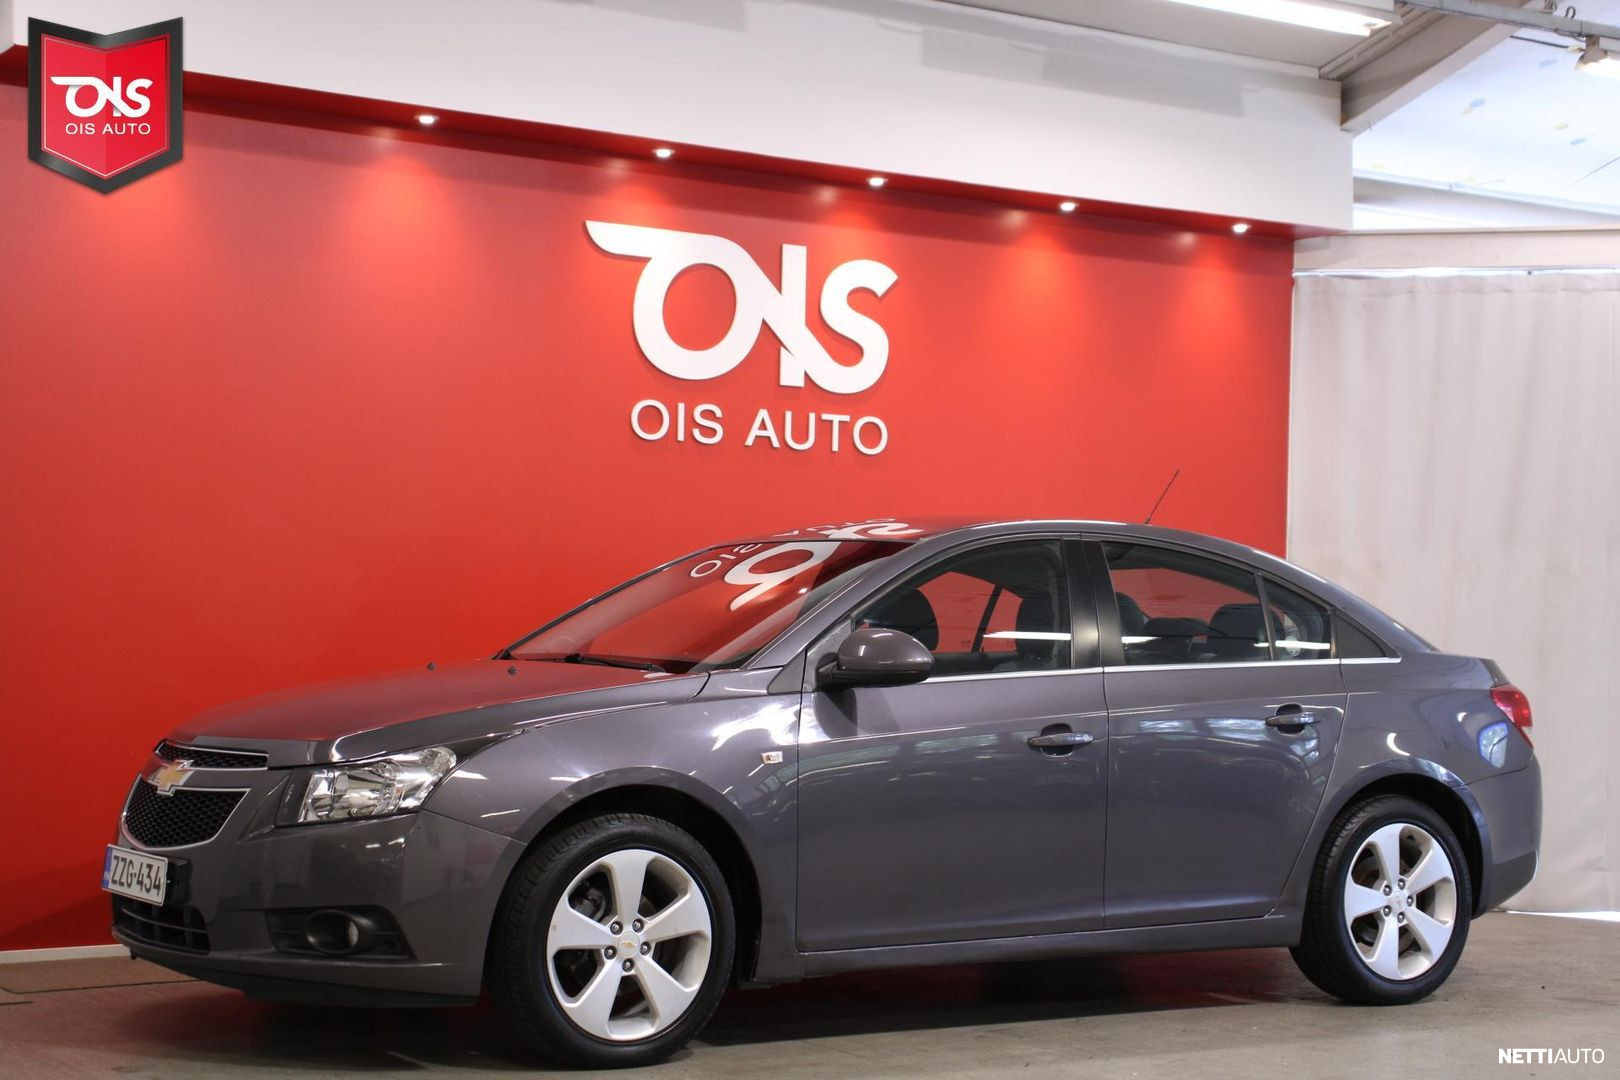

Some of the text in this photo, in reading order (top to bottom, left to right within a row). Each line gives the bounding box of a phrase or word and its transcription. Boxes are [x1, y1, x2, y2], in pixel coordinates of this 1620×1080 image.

[585, 220, 899, 394] OIS
[630, 399, 889, 456] OIS AUTO
[111, 855, 163, 897] ZZG-434
